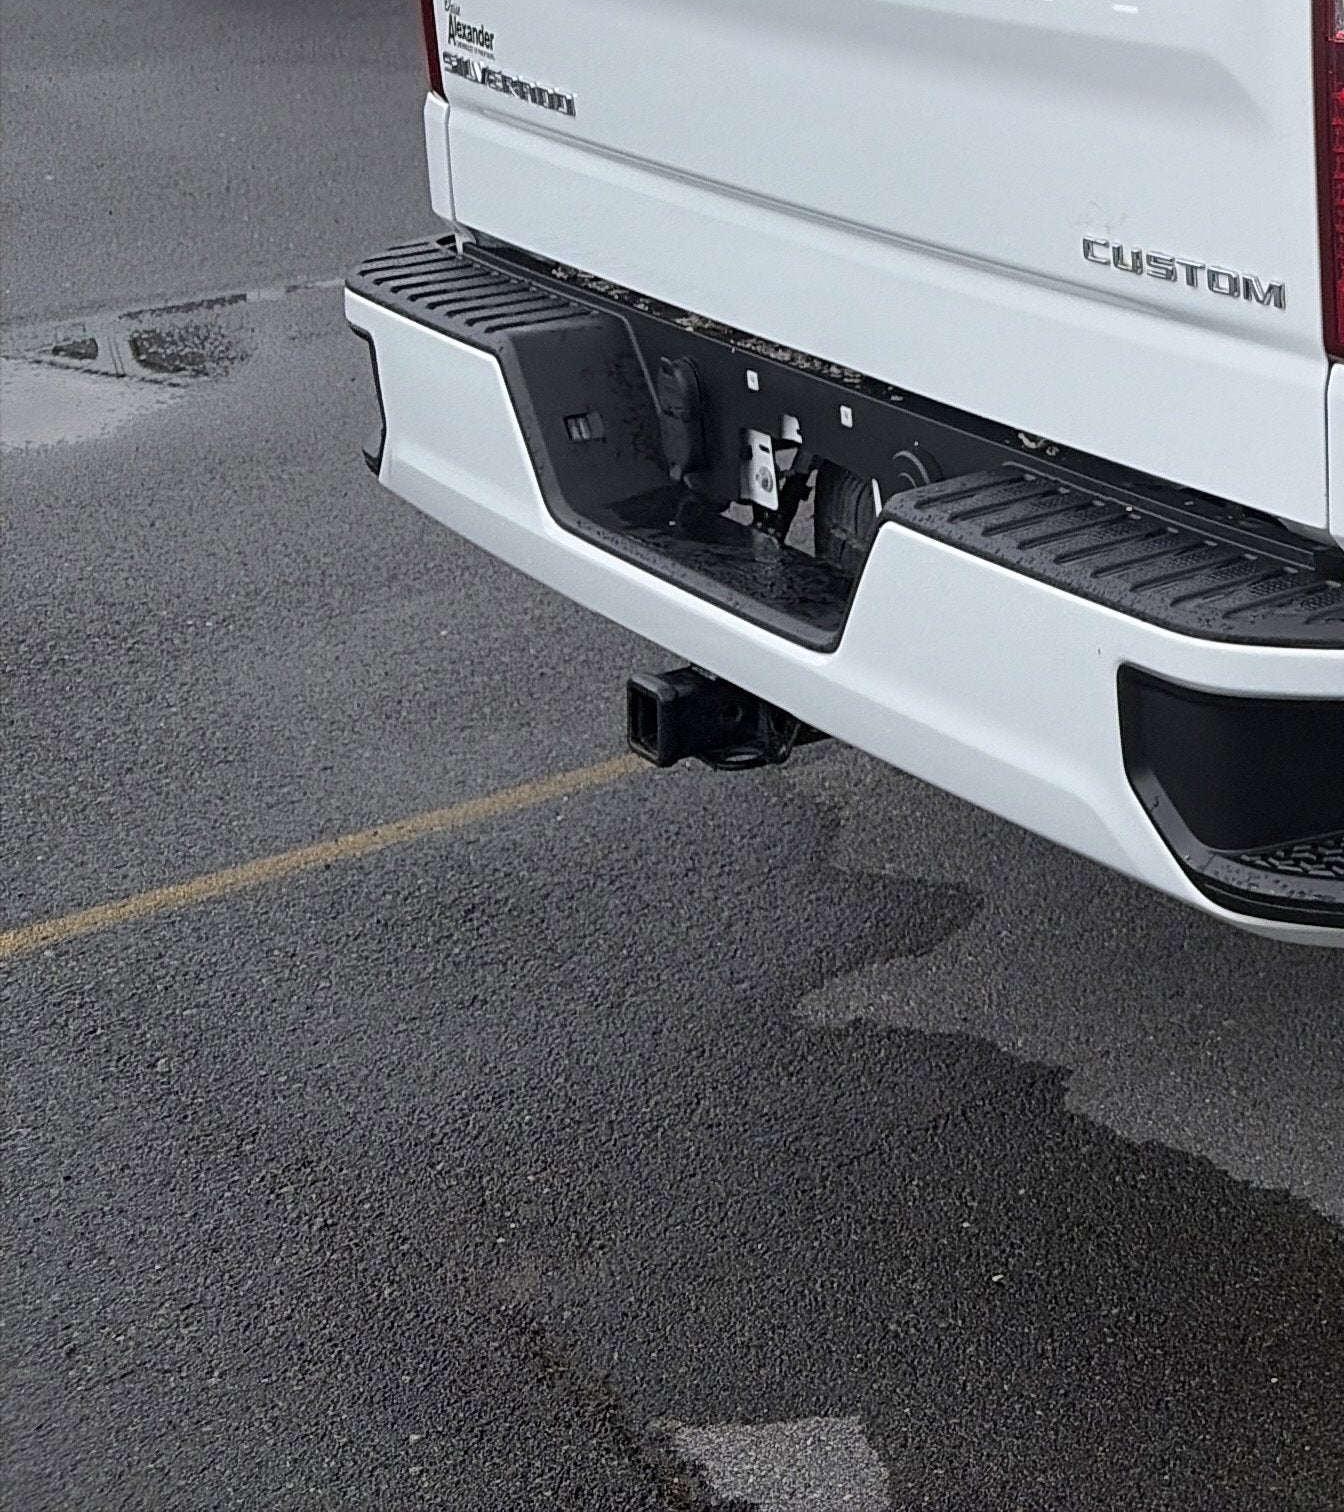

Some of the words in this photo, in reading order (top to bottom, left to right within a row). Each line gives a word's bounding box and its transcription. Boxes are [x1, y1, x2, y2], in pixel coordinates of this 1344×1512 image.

[448, 13, 495, 51] Alexander
[442, 50, 577, 118] SILVERADO
[1082, 235, 1287, 310] CUSTOM
